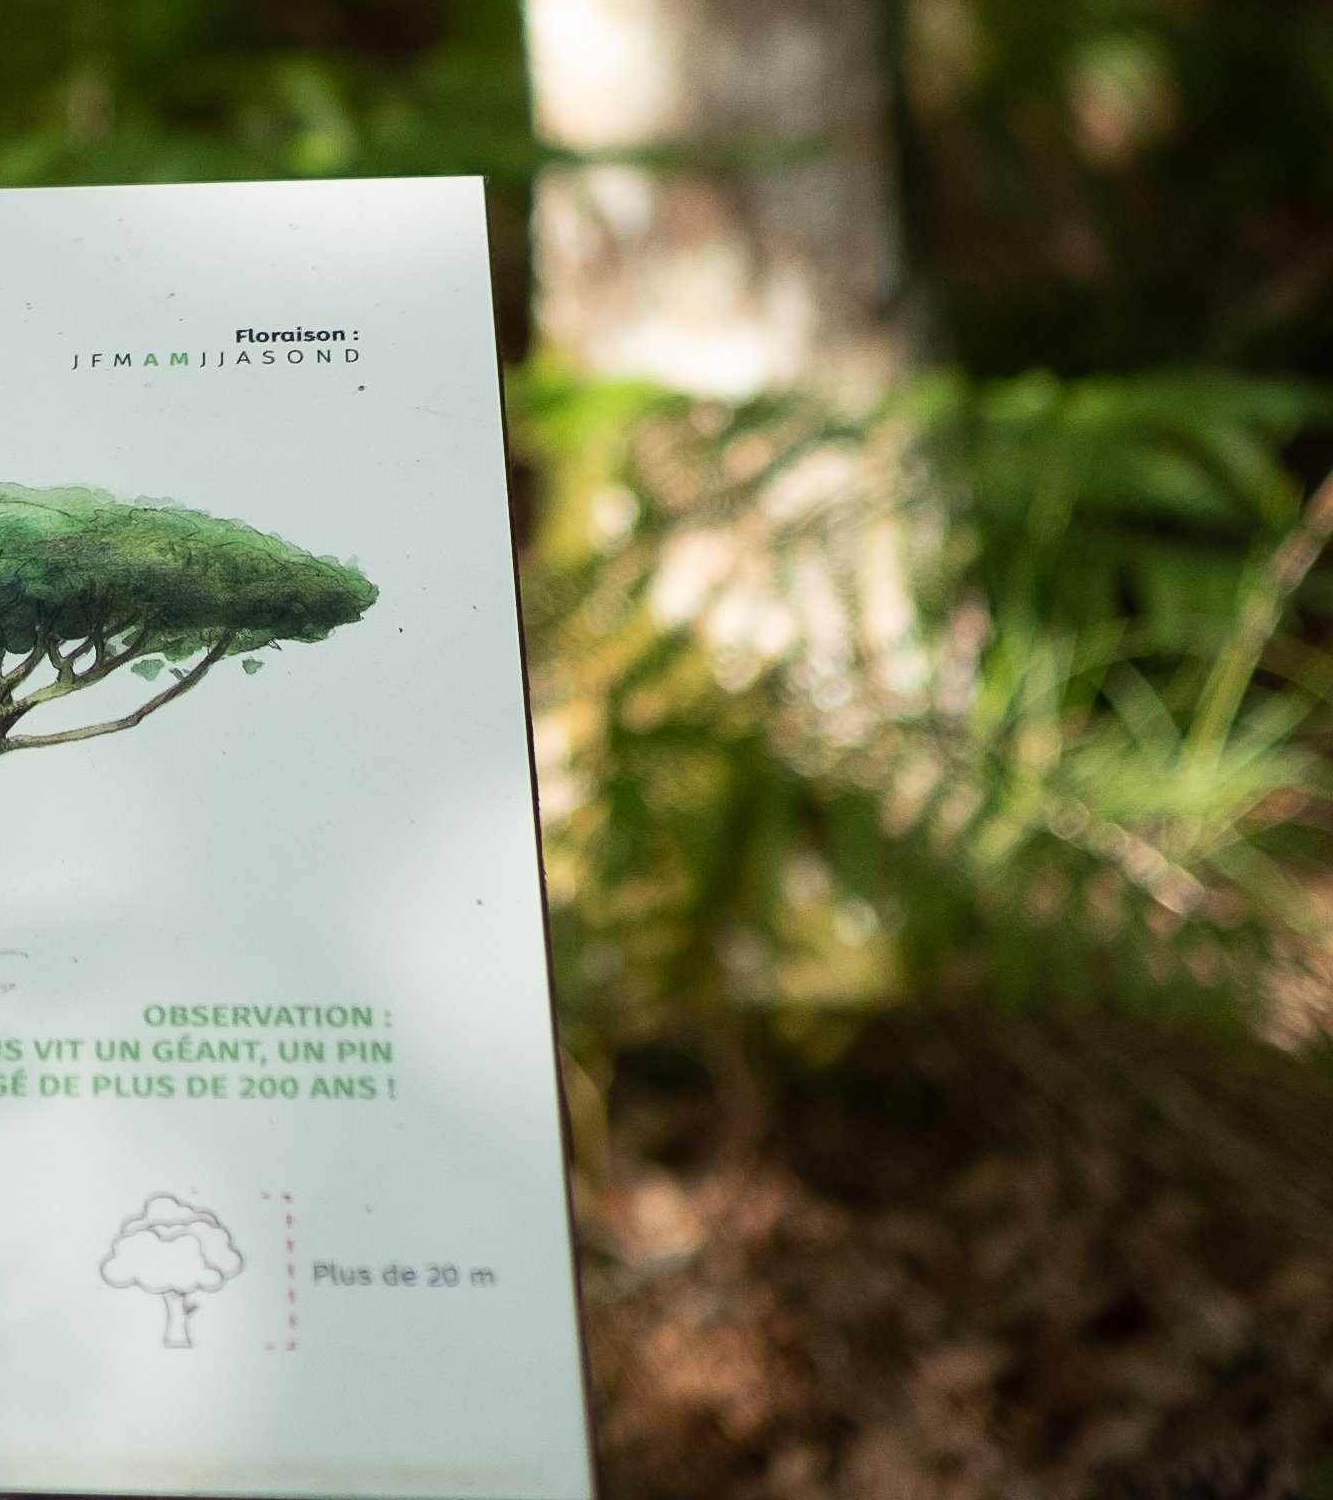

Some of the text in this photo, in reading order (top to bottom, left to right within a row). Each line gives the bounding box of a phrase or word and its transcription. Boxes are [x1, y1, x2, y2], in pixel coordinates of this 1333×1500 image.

[235, 326, 359, 344] Floraison :
[142, 1004, 391, 1028] OBSERVATION :
[33, 1039, 84, 1061] VIT
[94, 1039, 141, 1062] UN
[151, 1034, 267, 1065] GÉANT,
[278, 1040, 325, 1063] UN
[337, 1040, 393, 1064] PIN
[38, 1074, 77, 1098] DE
[92, 1075, 176, 1099] PLUS
[186, 1076, 227, 1099] DE
[239, 1076, 300, 1100] 200
[309, 1076, 379, 1101] ANS
[387, 1076, 396, 1100] !
[312, 1261, 497, 1288] Plus de 20 m
